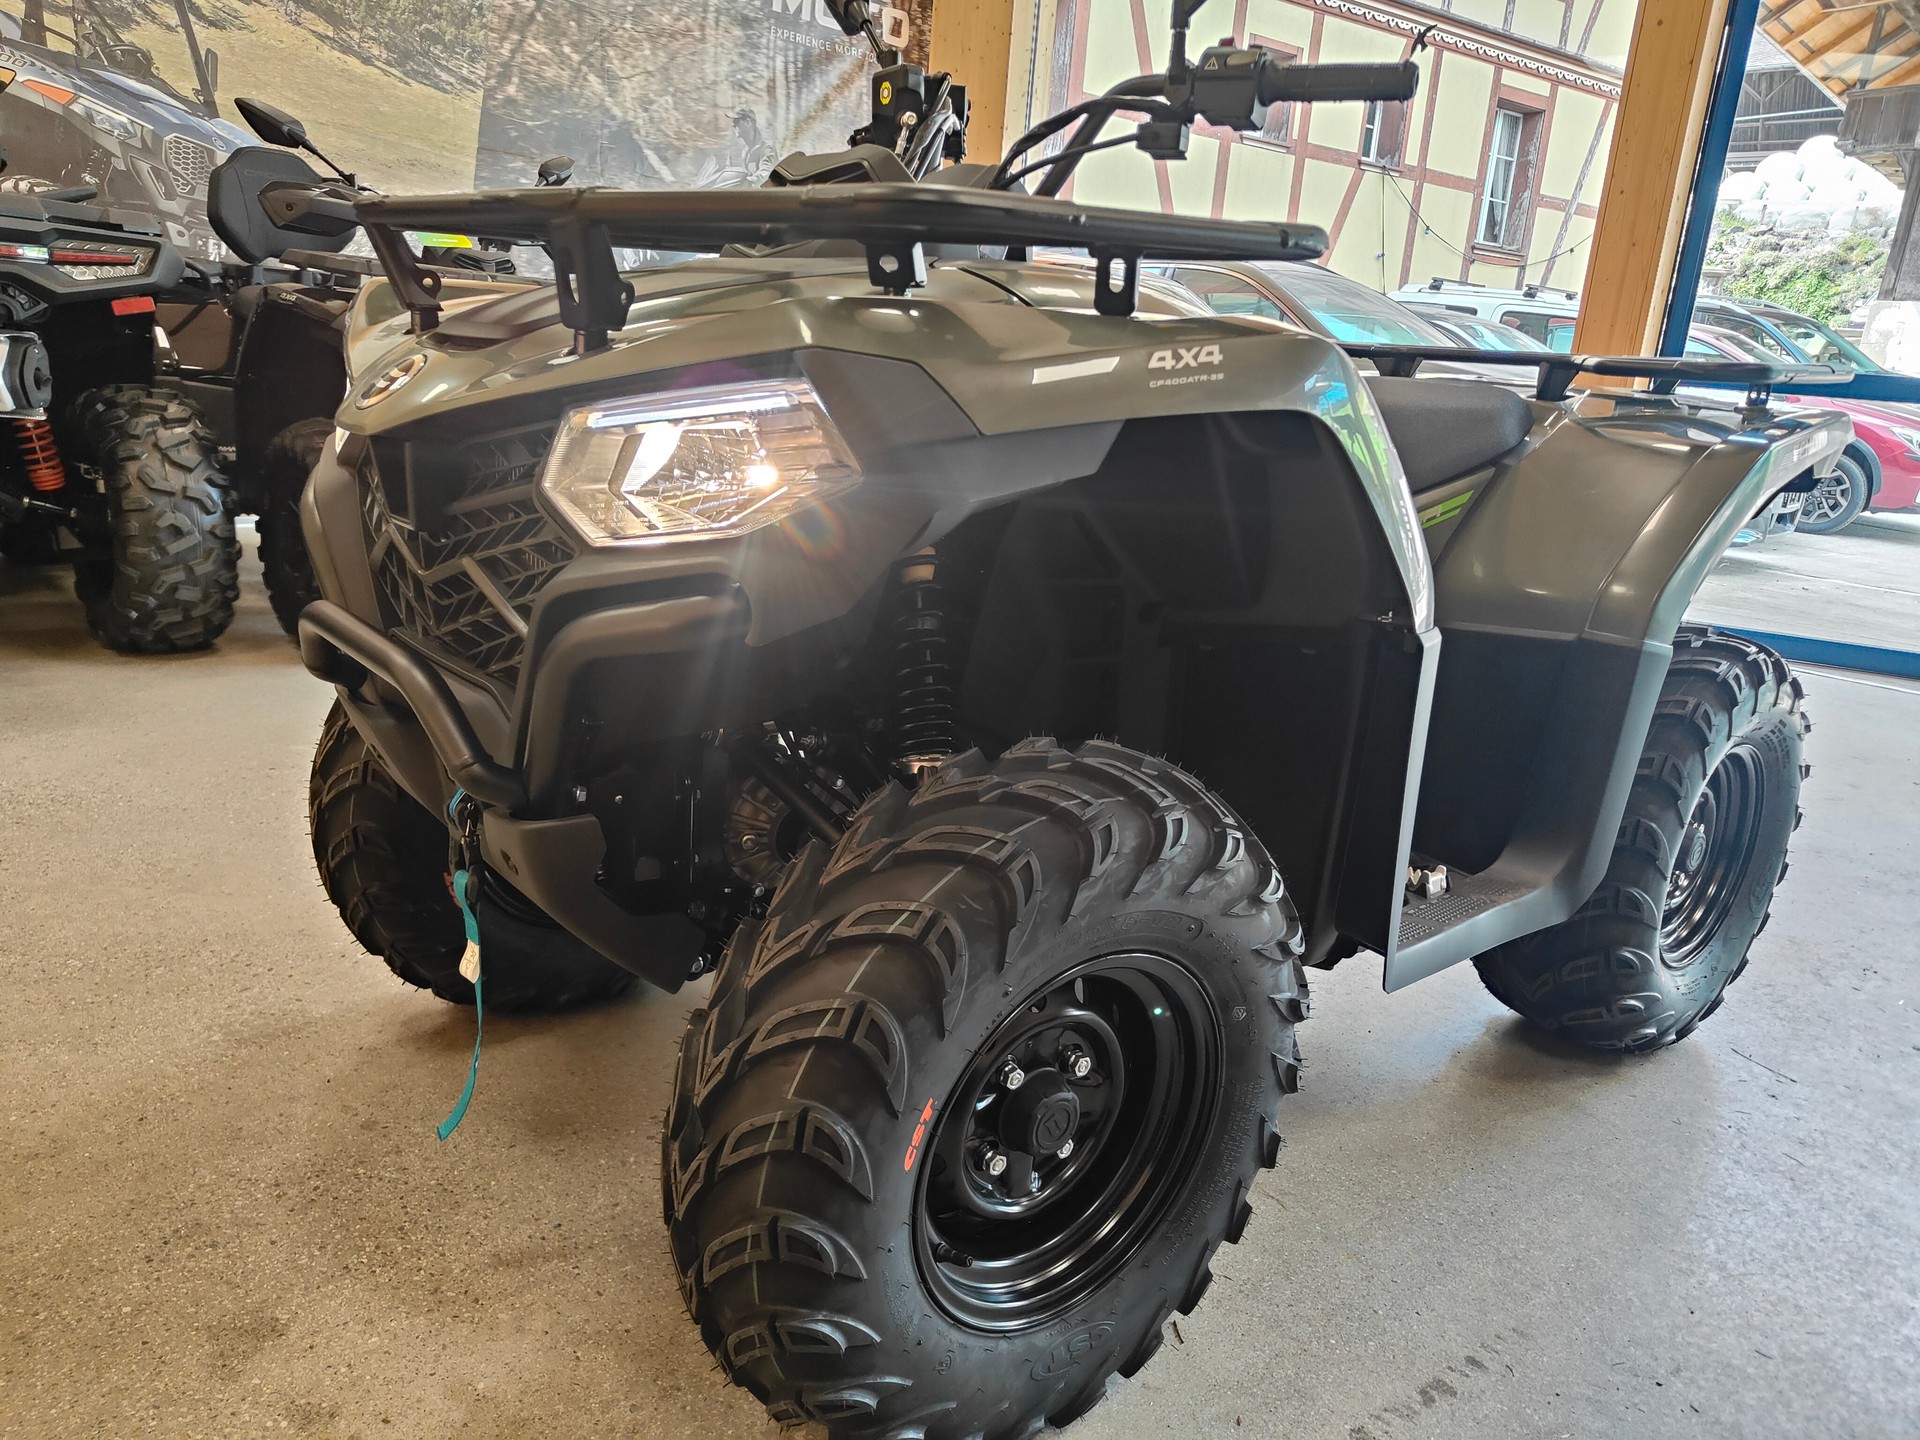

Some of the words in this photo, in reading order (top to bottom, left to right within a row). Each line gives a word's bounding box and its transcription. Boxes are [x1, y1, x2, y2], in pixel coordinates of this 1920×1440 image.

[770, 26, 831, 51] EXPERIENCE
[835, 44, 863, 59] MORE
[904, 1097, 934, 1171] CST
